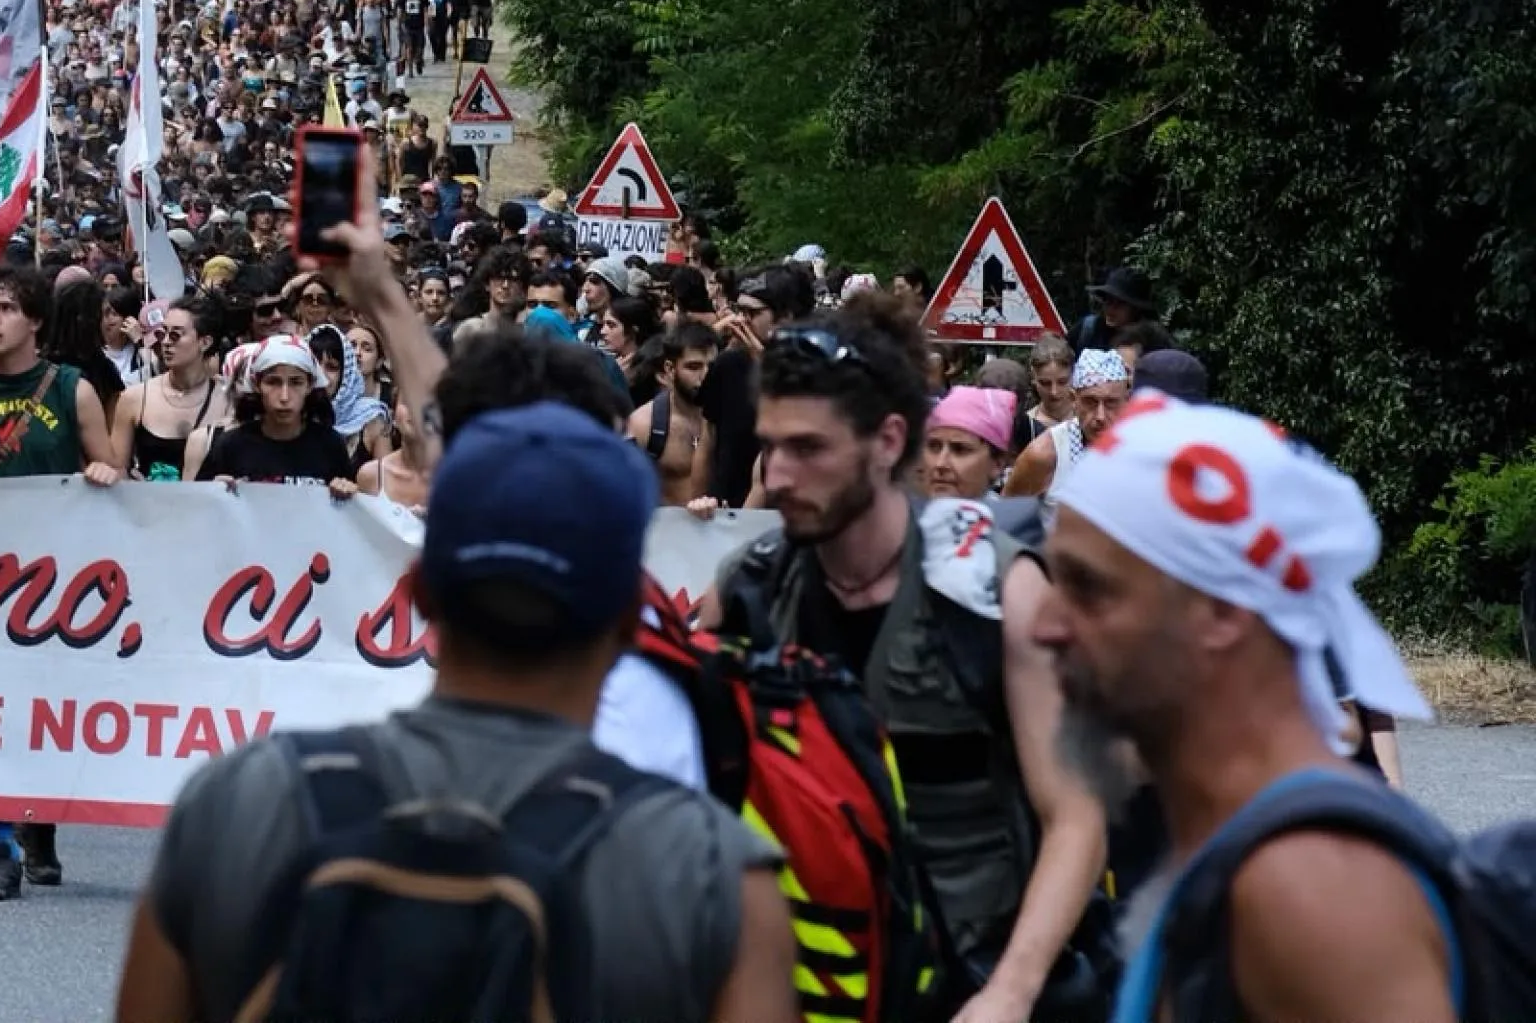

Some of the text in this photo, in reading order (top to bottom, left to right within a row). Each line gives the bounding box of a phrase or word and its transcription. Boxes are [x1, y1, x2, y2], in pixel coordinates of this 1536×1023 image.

[463, 129, 486, 140] 320
[578, 221, 670, 254] DEVIAZIONE
[204, 551, 332, 661] ci
